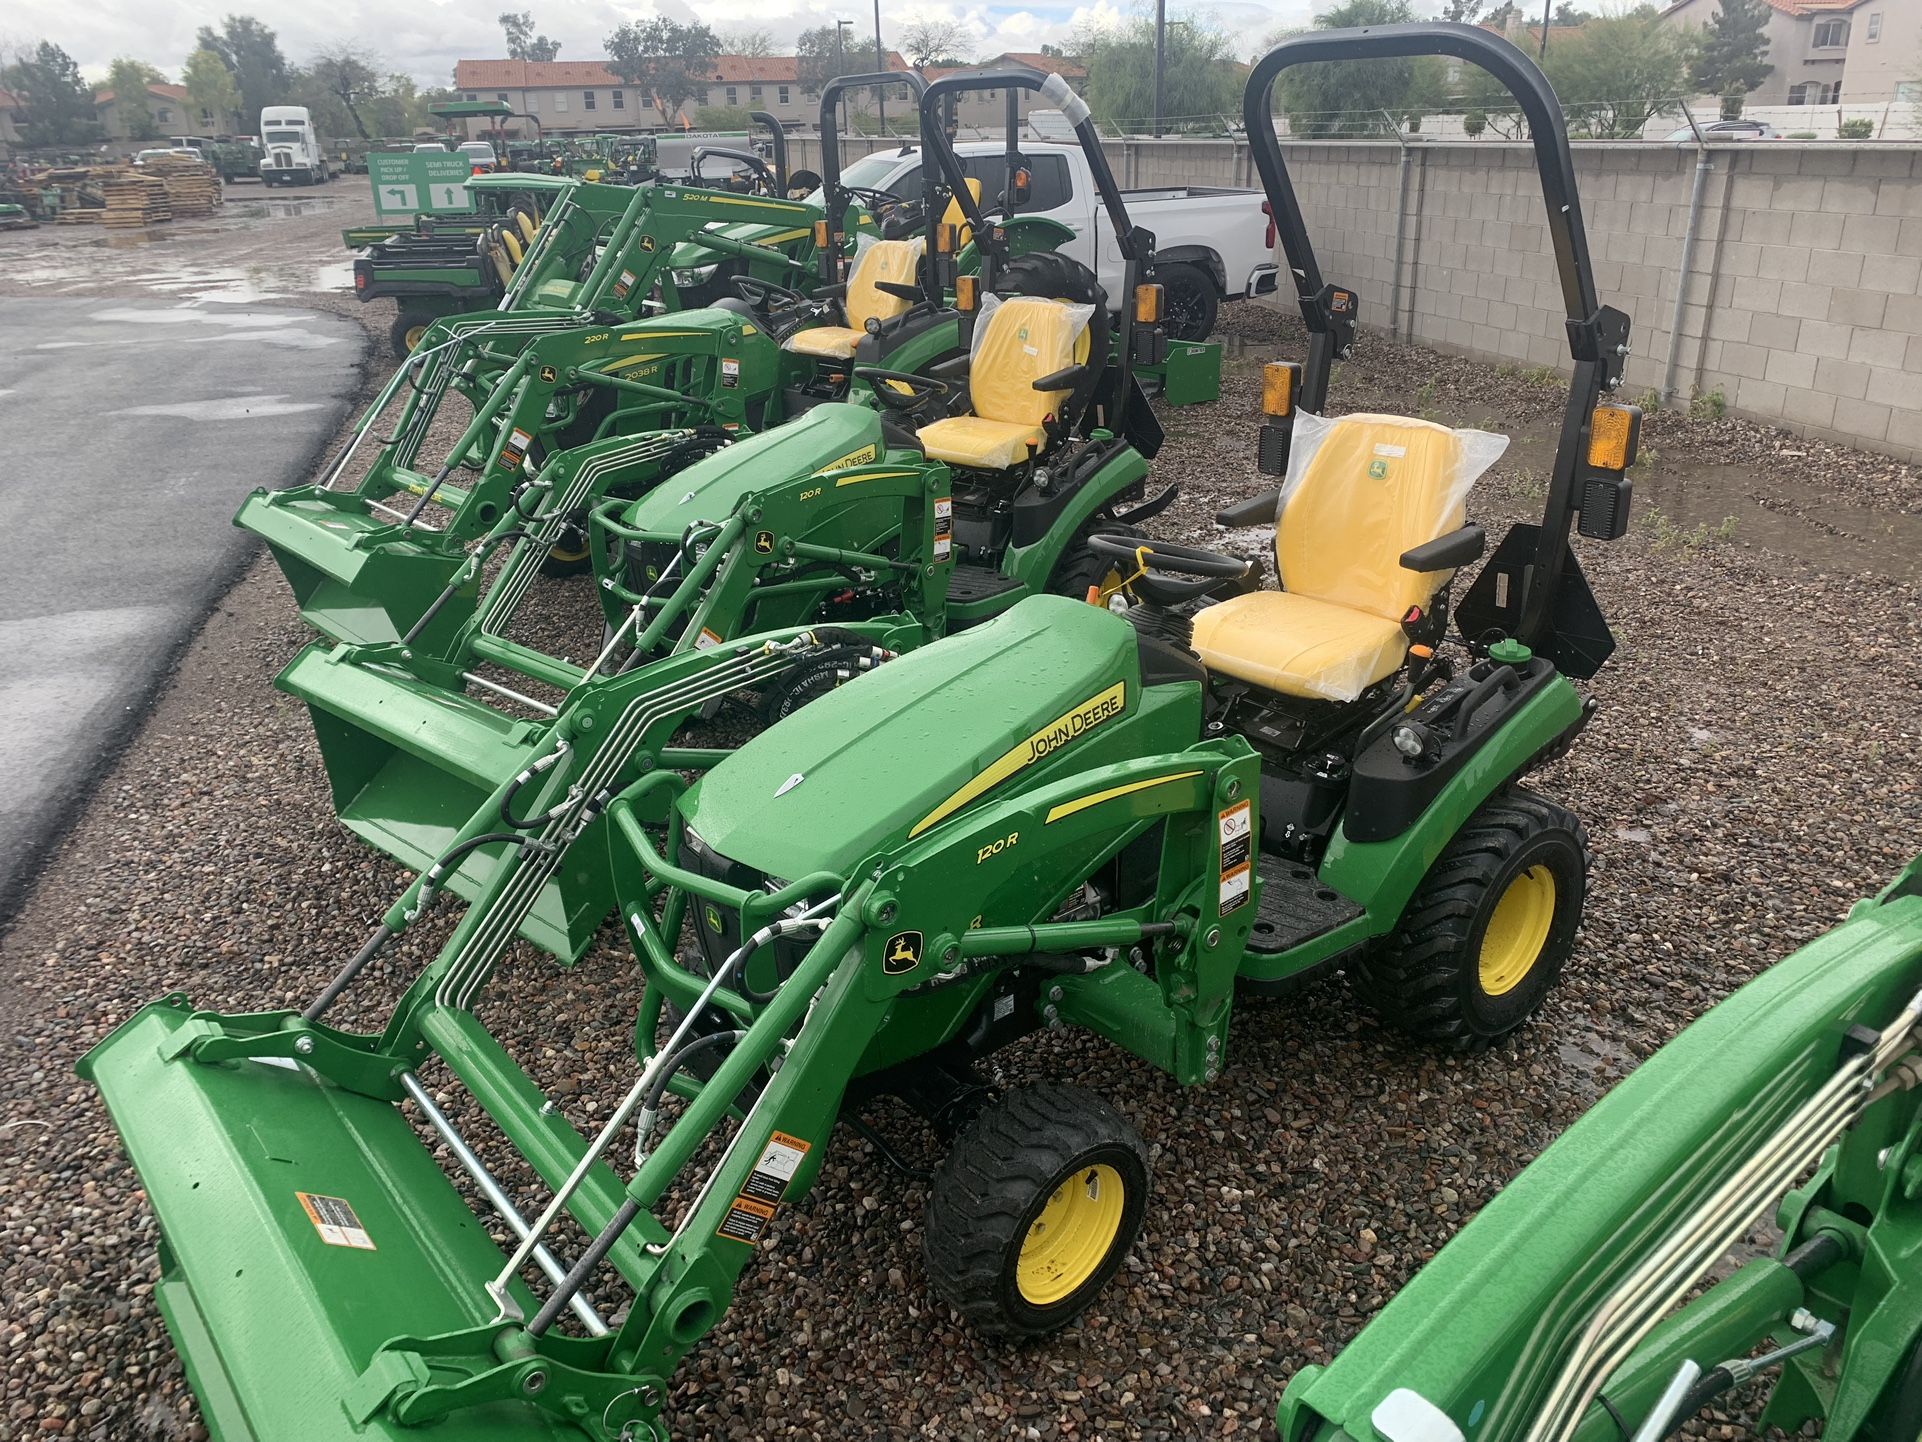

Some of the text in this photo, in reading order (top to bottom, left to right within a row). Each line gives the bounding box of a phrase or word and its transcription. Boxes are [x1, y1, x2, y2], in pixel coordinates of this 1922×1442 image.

[683, 193, 700, 201] 520
[584, 333, 609, 344] 220 R
[625, 365, 658, 381] 2038 R
[845, 451, 873, 467] DEERE
[800, 487, 822, 501] 120 R
[1027, 695, 1119, 763] JOHN DEERE
[1225, 800, 1249, 815] WARNING
[977, 832, 1019, 865] 120 R
[1225, 863, 1250, 878] WARNING
[781, 1135, 807, 1150] WARNING
[743, 1203, 769, 1216] WARNING
